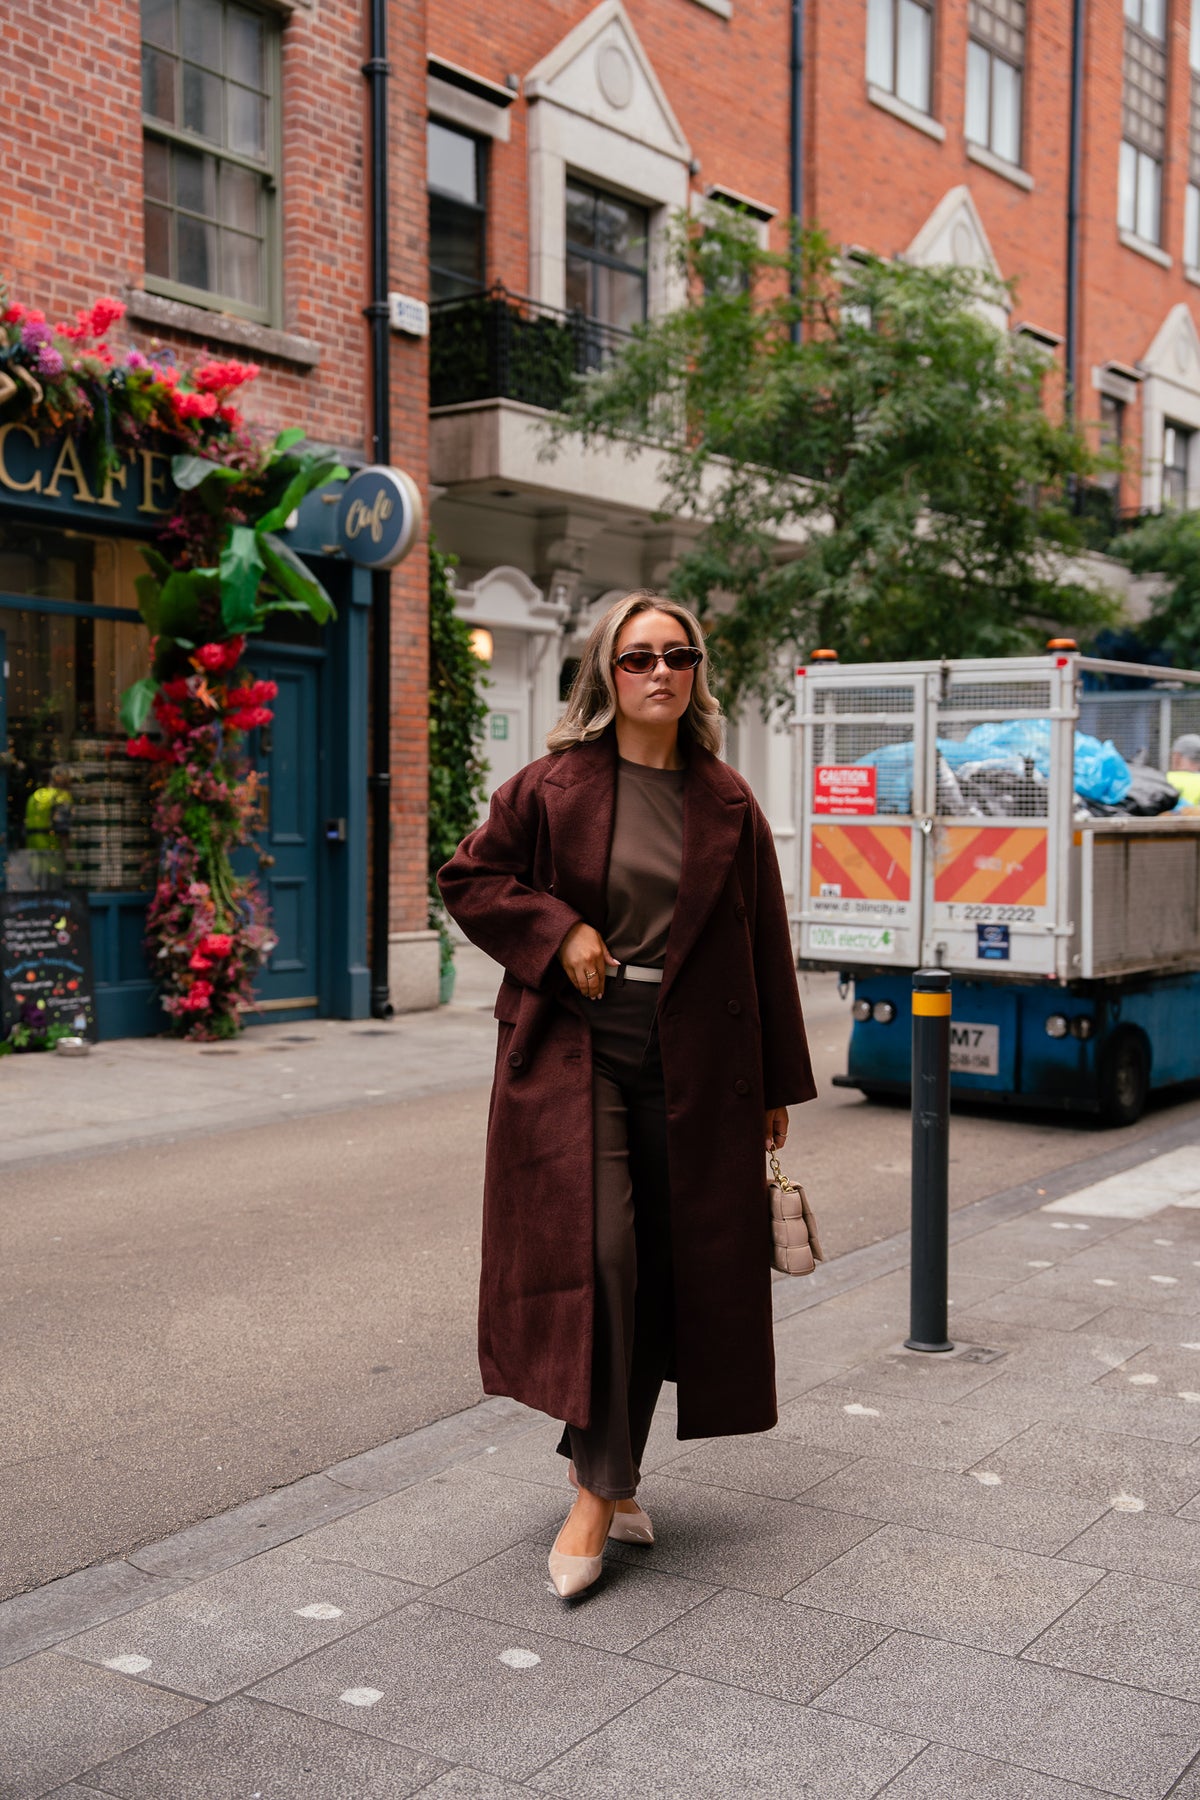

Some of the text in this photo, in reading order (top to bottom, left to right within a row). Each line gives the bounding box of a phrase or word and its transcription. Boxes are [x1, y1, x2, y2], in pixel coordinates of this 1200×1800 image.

[819, 769, 868, 783] CAUTION
[814, 902, 907, 914] www.dblincity.ie
[964, 905, 993, 920] 222
[997, 906, 1035, 921] 2222
[812, 928, 877, 947] 100% electric
